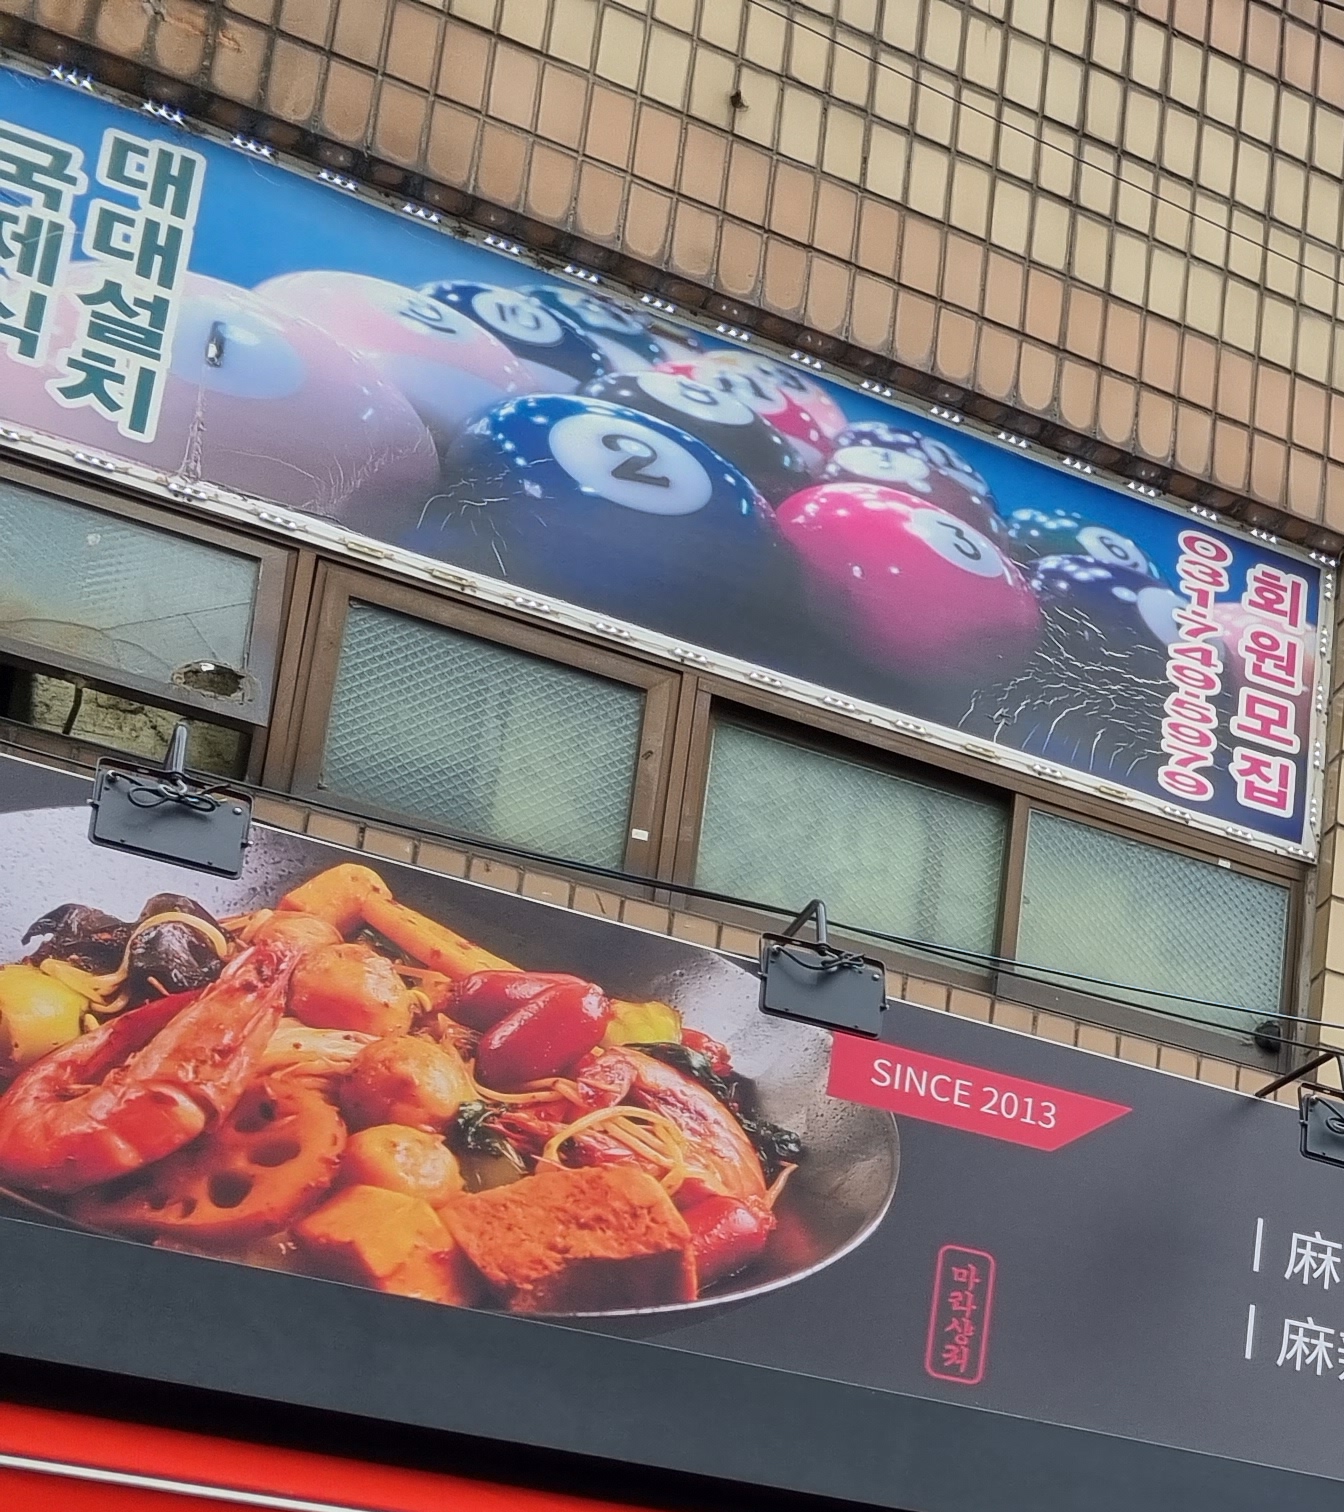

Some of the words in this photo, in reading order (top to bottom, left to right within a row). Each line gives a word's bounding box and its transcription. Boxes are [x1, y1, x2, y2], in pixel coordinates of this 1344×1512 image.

[56, 135, 198, 435] 대대설치
[1236, 569, 1303, 812] 회원모집
[870, 1057, 972, 1110] SINCE
[978, 1084, 1060, 1132] 2013
